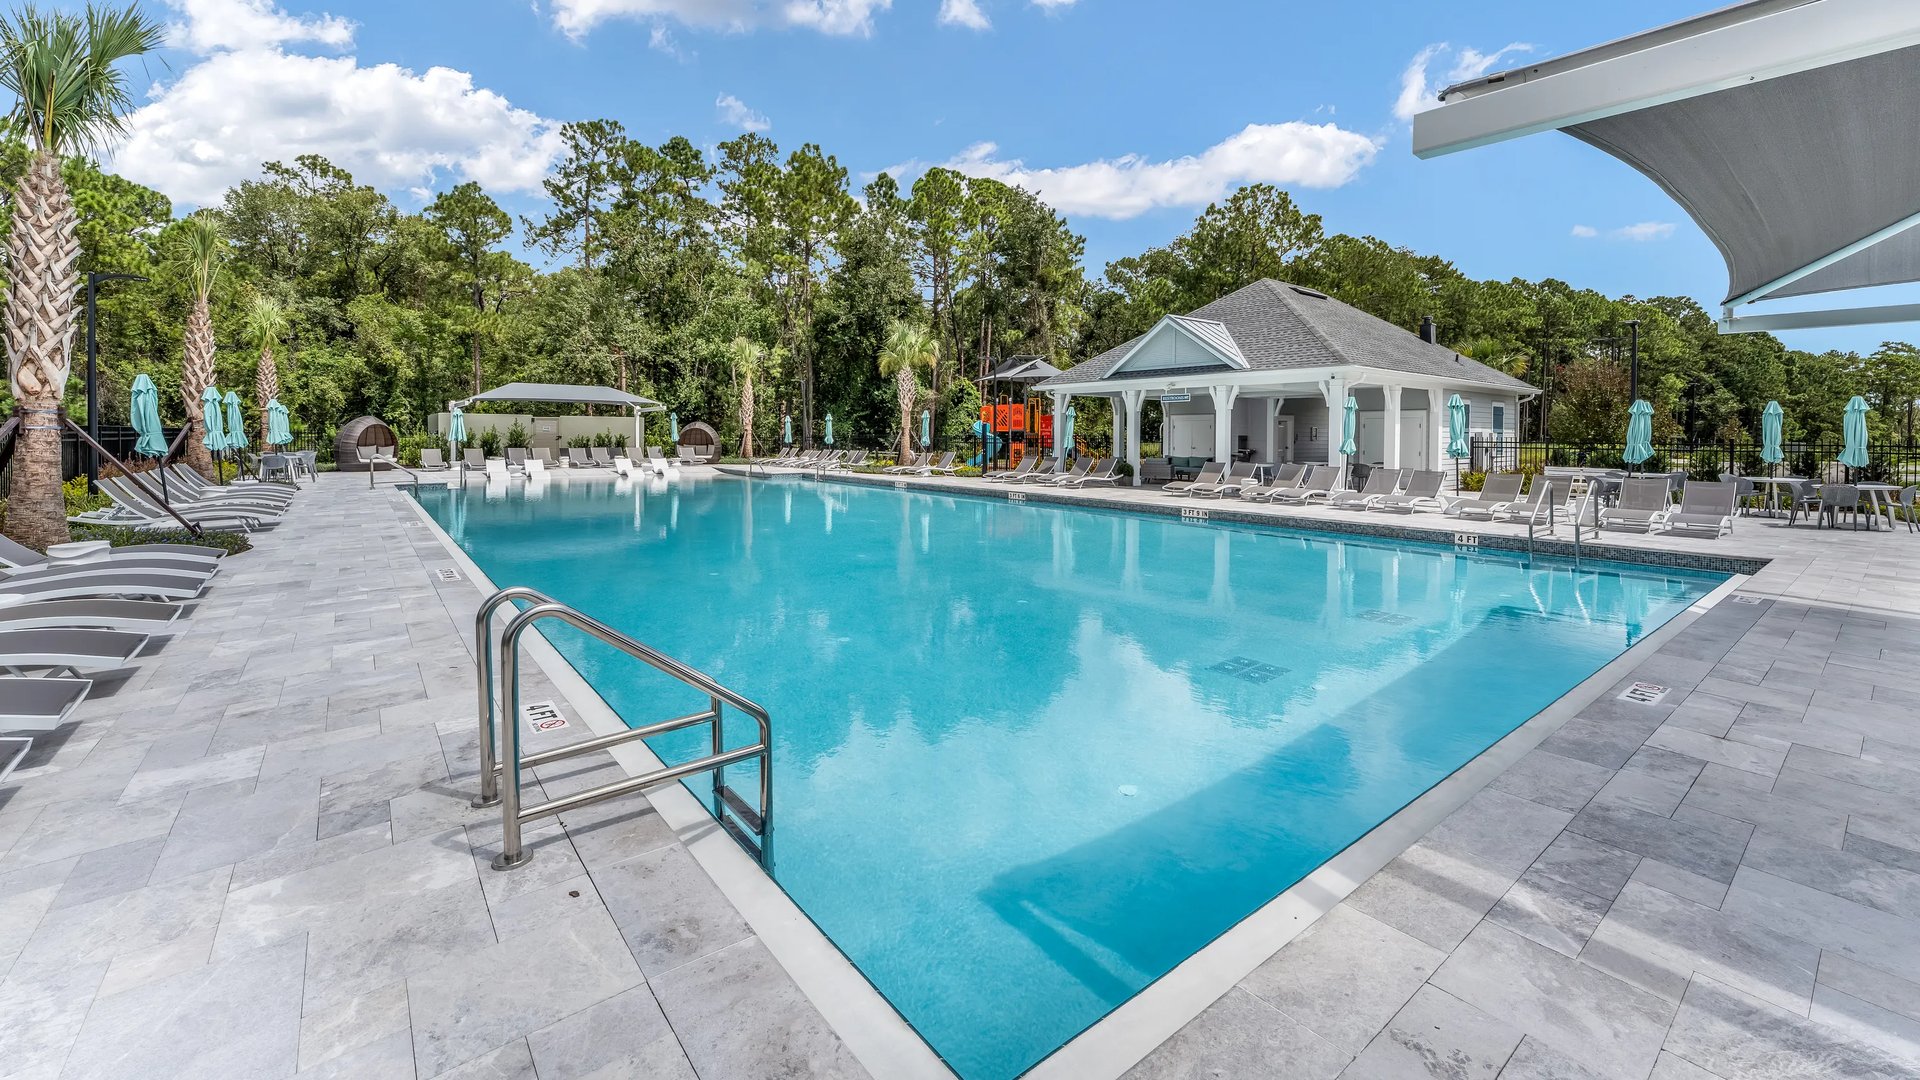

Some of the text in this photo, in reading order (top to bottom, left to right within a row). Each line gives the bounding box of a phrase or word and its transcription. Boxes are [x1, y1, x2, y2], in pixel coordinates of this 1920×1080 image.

[1466, 536, 1477, 544] FT
[1629, 688, 1659, 699] FT
[529, 709, 558, 721] FT
